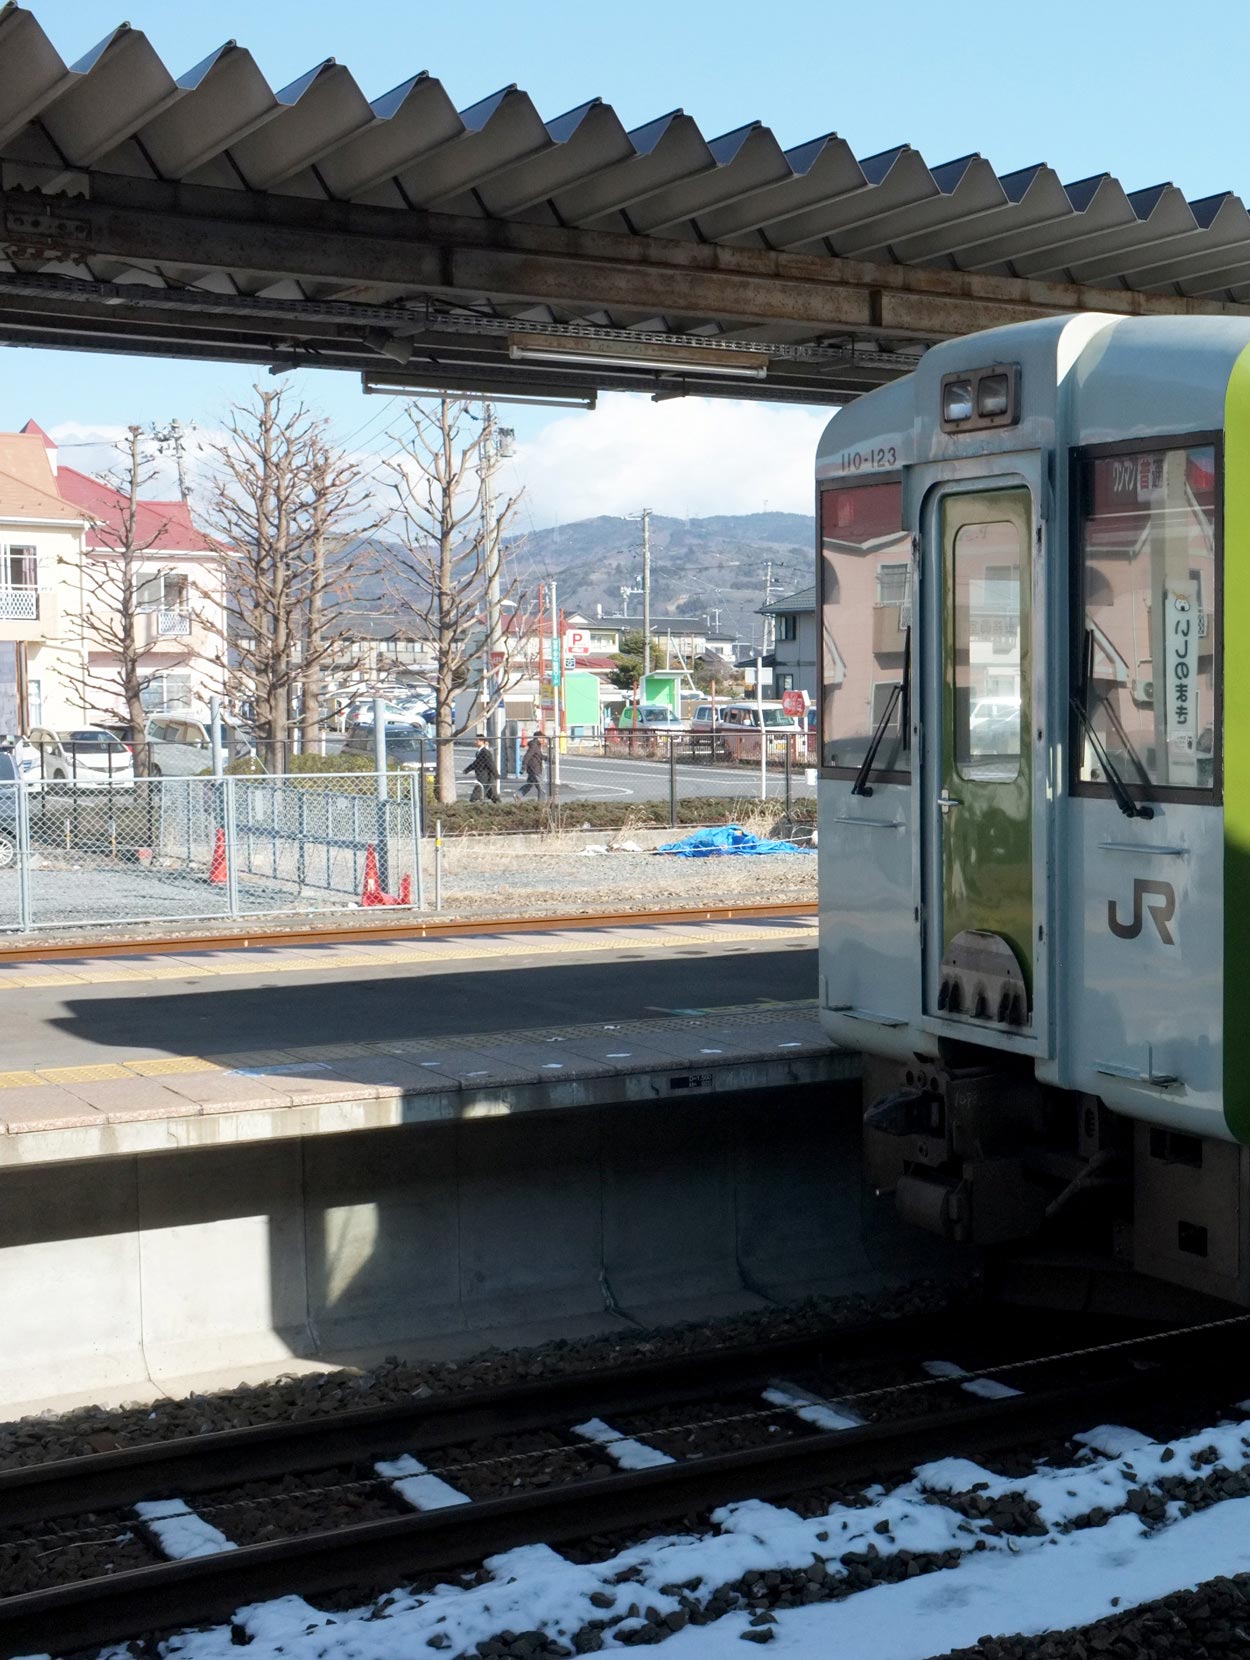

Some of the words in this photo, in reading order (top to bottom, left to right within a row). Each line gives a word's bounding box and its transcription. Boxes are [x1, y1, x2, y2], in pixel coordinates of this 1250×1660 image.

[841, 446, 897, 472] 110-123
[1112, 460, 1136, 493] ワンマン
[1140, 458, 1164, 490] 普通
[572, 633, 583, 646] P
[1108, 878, 1176, 946] JR
